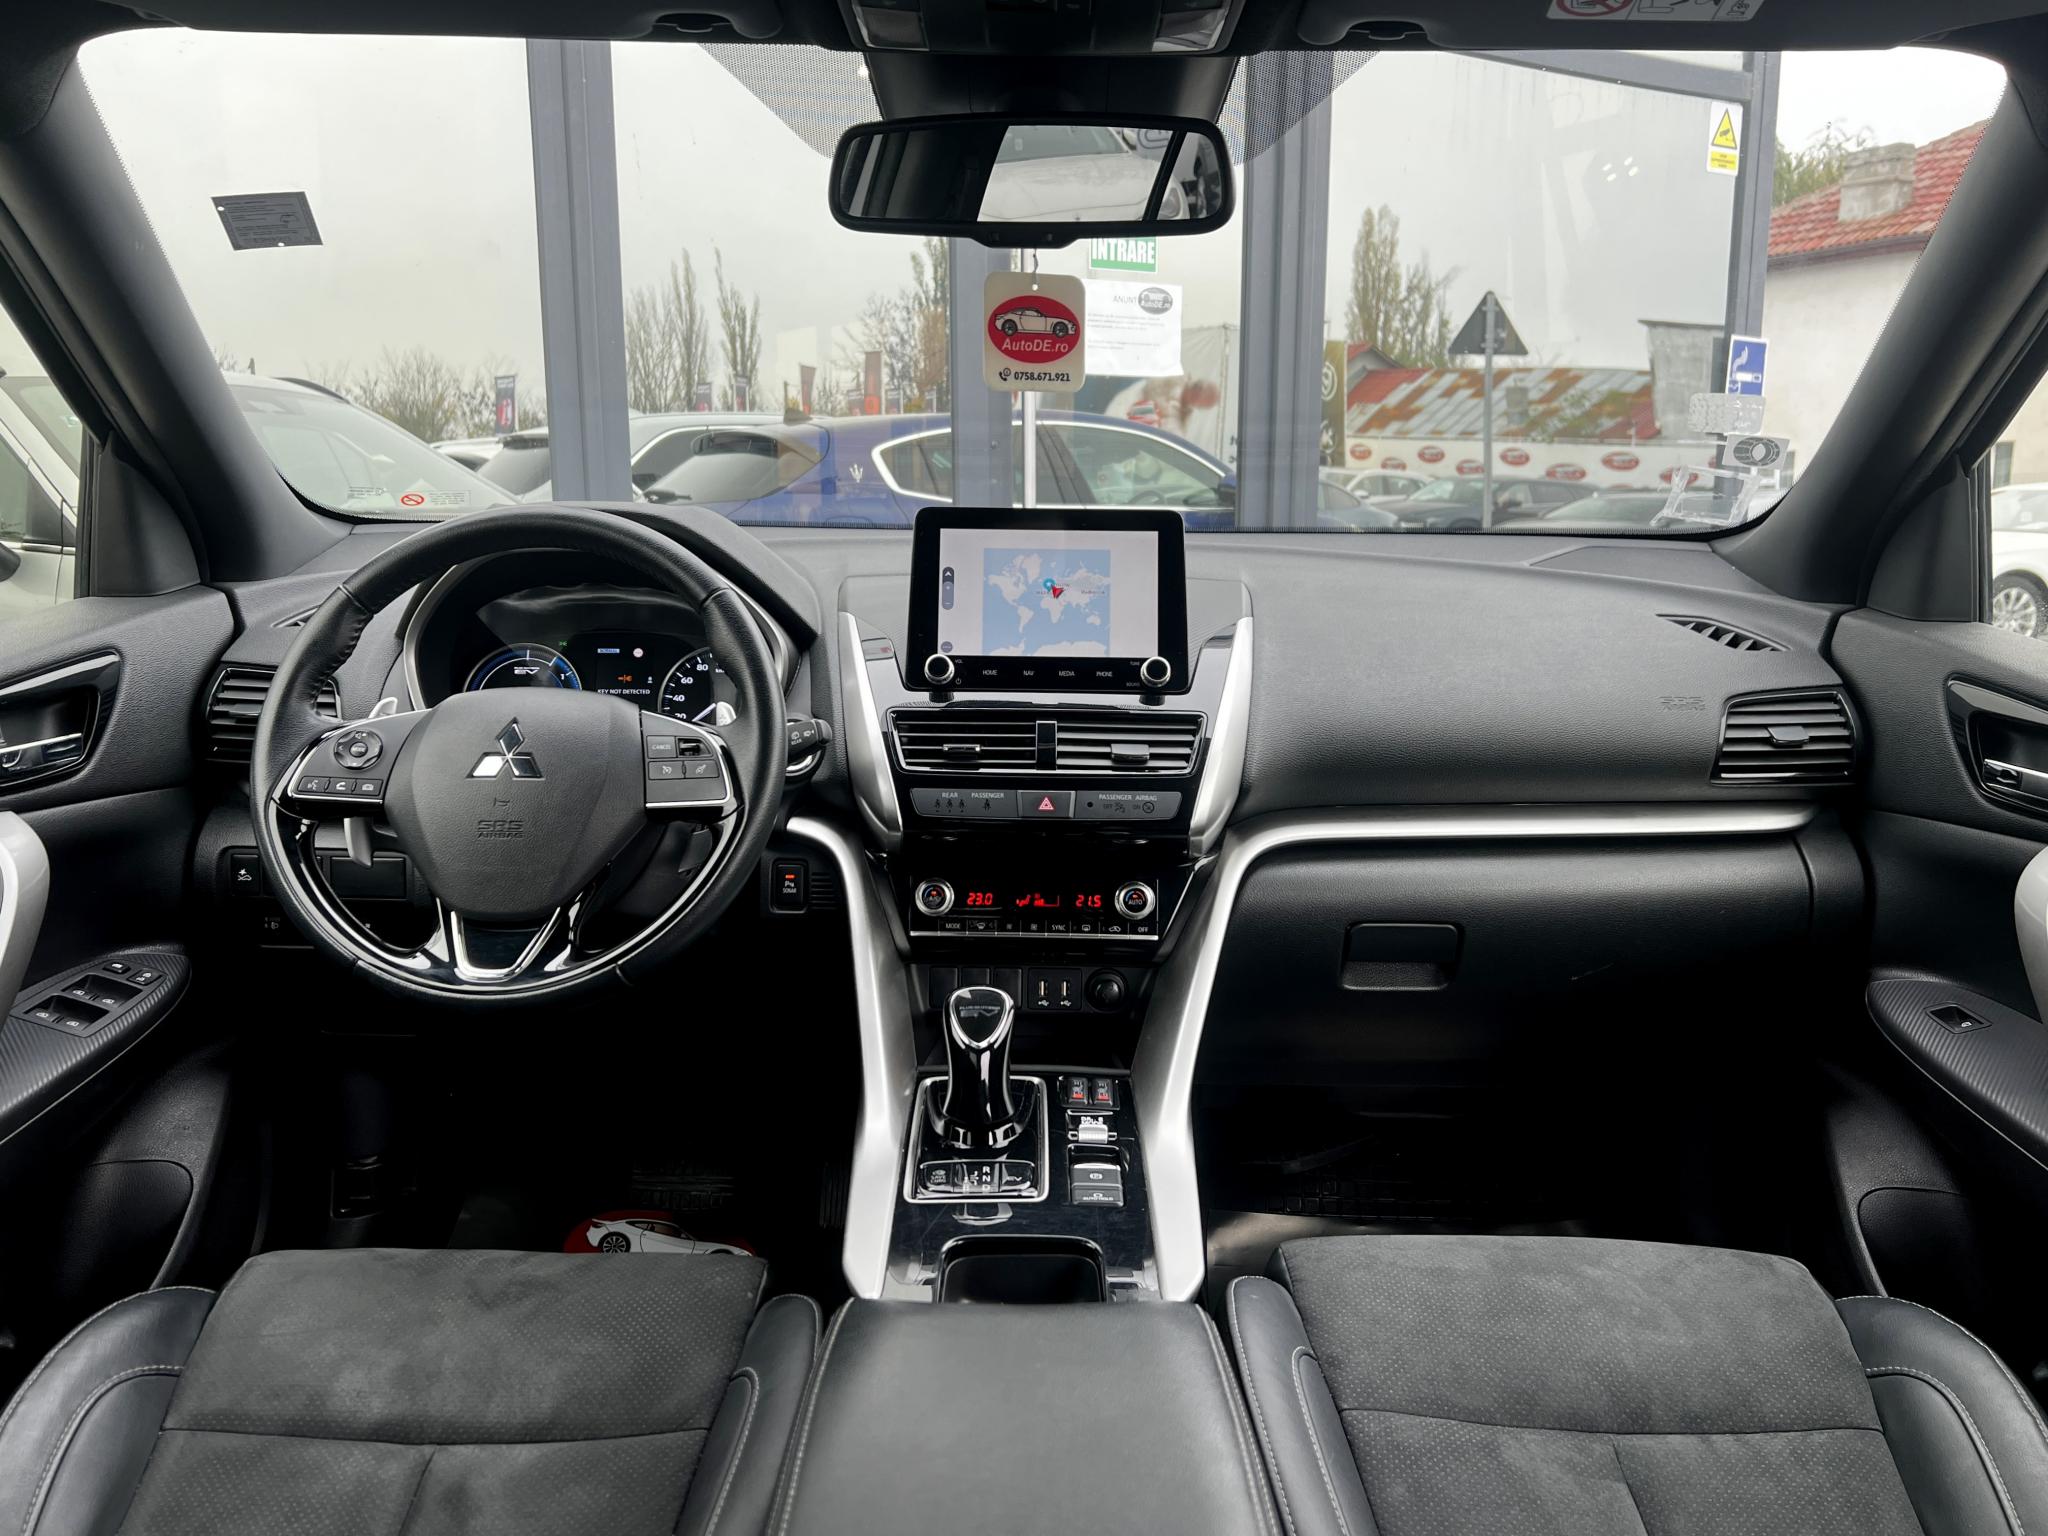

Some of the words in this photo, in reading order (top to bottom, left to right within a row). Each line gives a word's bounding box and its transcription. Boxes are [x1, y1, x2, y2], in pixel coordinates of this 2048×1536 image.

[1092, 238, 1155, 264] INTRARE
[1002, 338, 1069, 352] AutoDE.ro
[1014, 371, 1070, 382] 0758.671.921
[681, 676, 693, 684] 60
[478, 820, 524, 832] SRS
[966, 892, 993, 906] 23.0
[1075, 894, 1102, 907] 21.5
[982, 1166, 991, 1174] R
[982, 1184, 991, 1192] D
